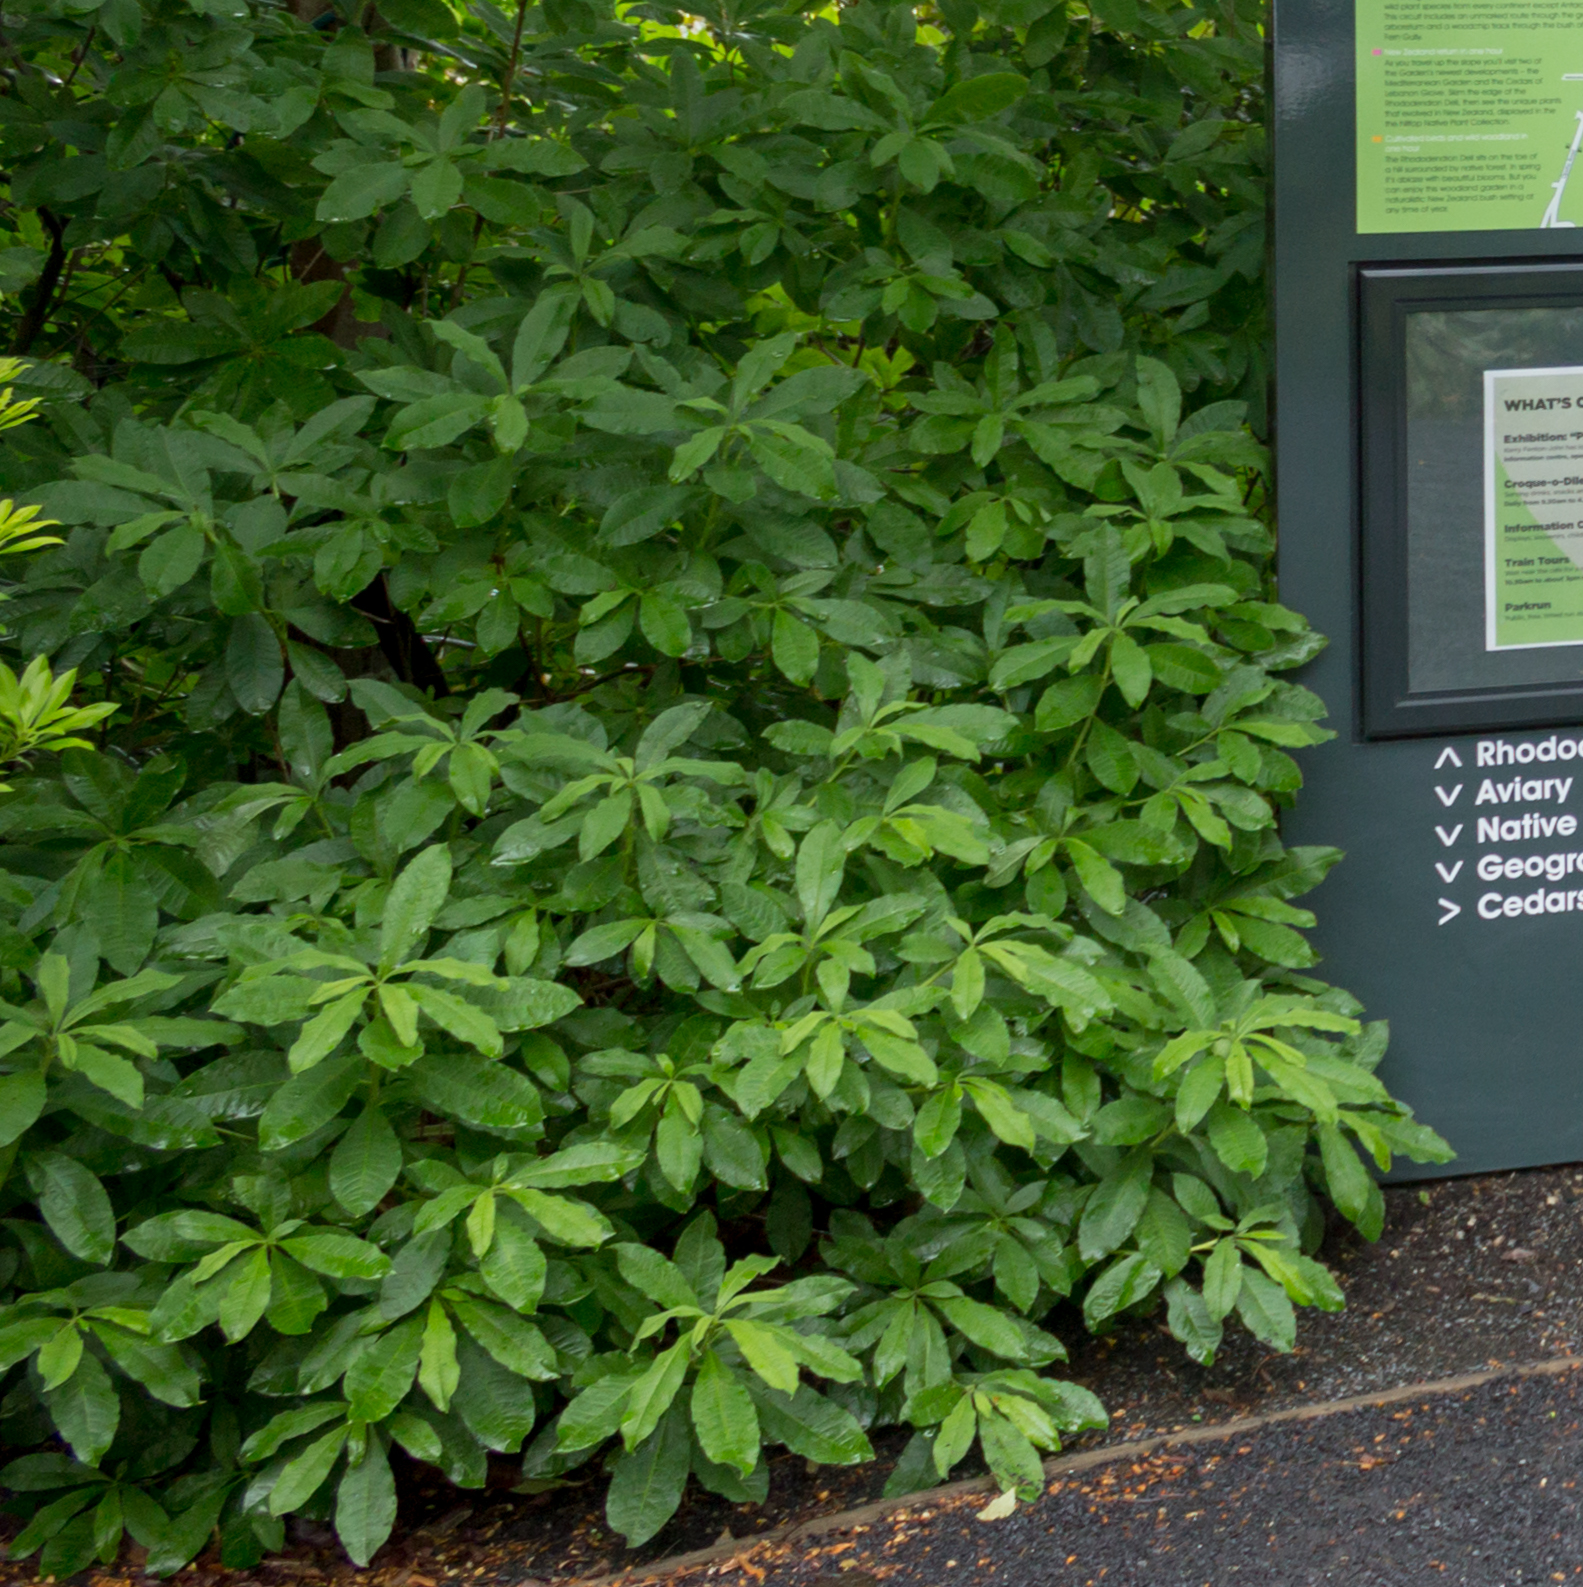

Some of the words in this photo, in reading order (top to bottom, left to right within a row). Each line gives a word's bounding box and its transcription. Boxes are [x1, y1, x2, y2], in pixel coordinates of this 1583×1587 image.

[1505, 397, 1571, 411] WHAT'S
[1504, 433, 1567, 443] Exhibition:
[1503, 454, 1544, 462] Information
[1504, 522, 1574, 533] Information
[1505, 558, 1534, 567] Train
[1537, 556, 1570, 565] Tours
[1505, 602, 1551, 611] Parkrun
[1475, 776, 1573, 805] Aviary
[1478, 812, 1578, 843] Native
